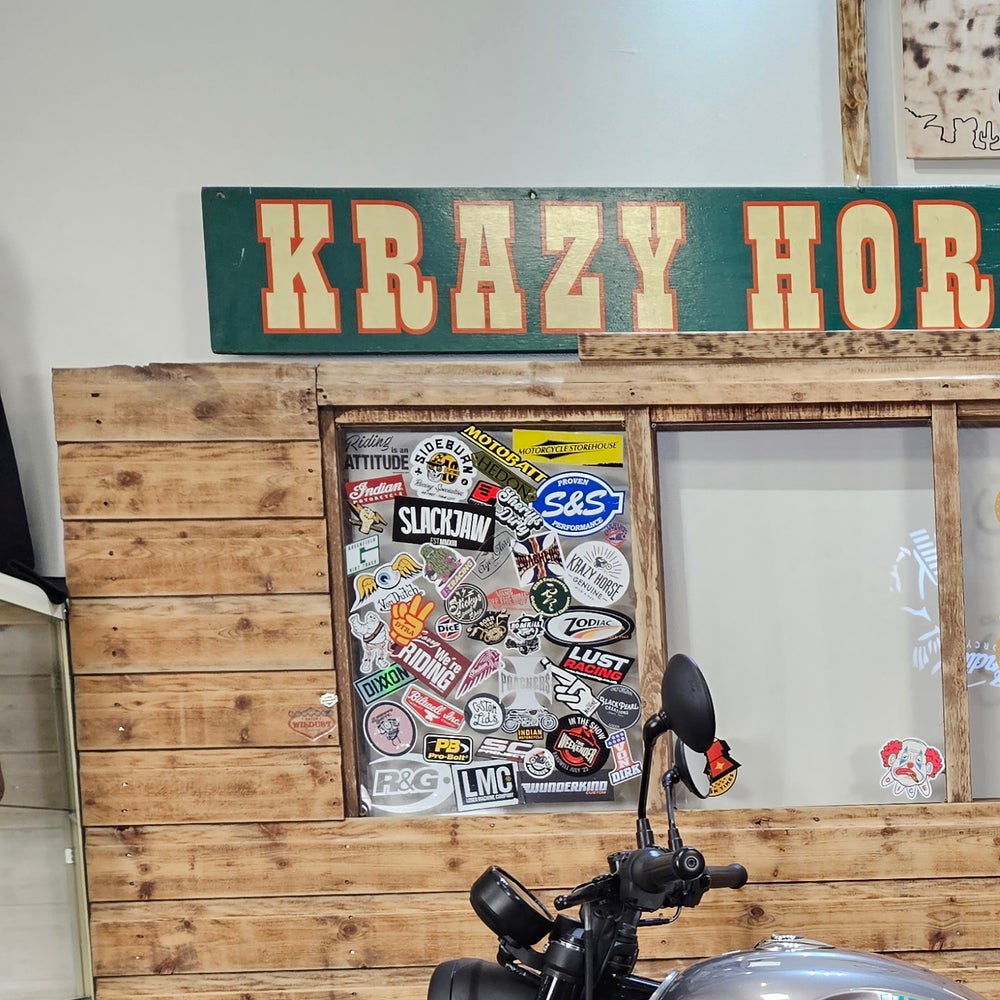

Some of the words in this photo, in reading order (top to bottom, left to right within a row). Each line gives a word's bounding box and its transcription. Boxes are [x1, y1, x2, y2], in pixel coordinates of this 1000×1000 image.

[256, 199, 686, 335] KRAZY
[344, 434, 393, 452] Riding
[463, 424, 548, 483] MOTOBATT
[518, 444, 568, 456] MOTORCYCLE
[569, 440, 620, 452] STOREHOUSE
[345, 454, 409, 470] ATTITUDE
[415, 438, 473, 474] SIDEBURN
[478, 455, 531, 499] HEDON
[557, 477, 590, 487] PROVEN
[349, 481, 404, 500] Indian
[541, 489, 608, 518] S&S
[398, 506, 492, 544] SLACKJAW
[551, 516, 604, 532] PERFORMANCE
[567, 553, 597, 581] KRAZY
[593, 573, 624, 602] HORSE
[572, 576, 603, 600] GENUINE
[394, 620, 415, 637] DTRA
[564, 617, 612, 637] ZODIAC
[398, 643, 456, 692] RIDING
[434, 647, 462, 674] We're
[563, 659, 624, 681] RACING
[568, 645, 630, 671] LUST
[361, 664, 411, 698] DIXXON
[407, 690, 444, 716] Biltwell
[599, 695, 619, 708] BLACK
[618, 701, 640, 711] PEARL
[518, 729, 543, 737] INDIAN
[567, 717, 577, 726] IN
[577, 716, 591, 727] THE
[589, 721, 607, 740] SHOW
[434, 738, 462, 753] PB
[557, 732, 598, 764] WEEKENDER
[375, 767, 440, 795] R&G
[461, 766, 513, 798] LMC
[611, 764, 642, 783] DIRK
[521, 780, 609, 794] WUNDERKIND
